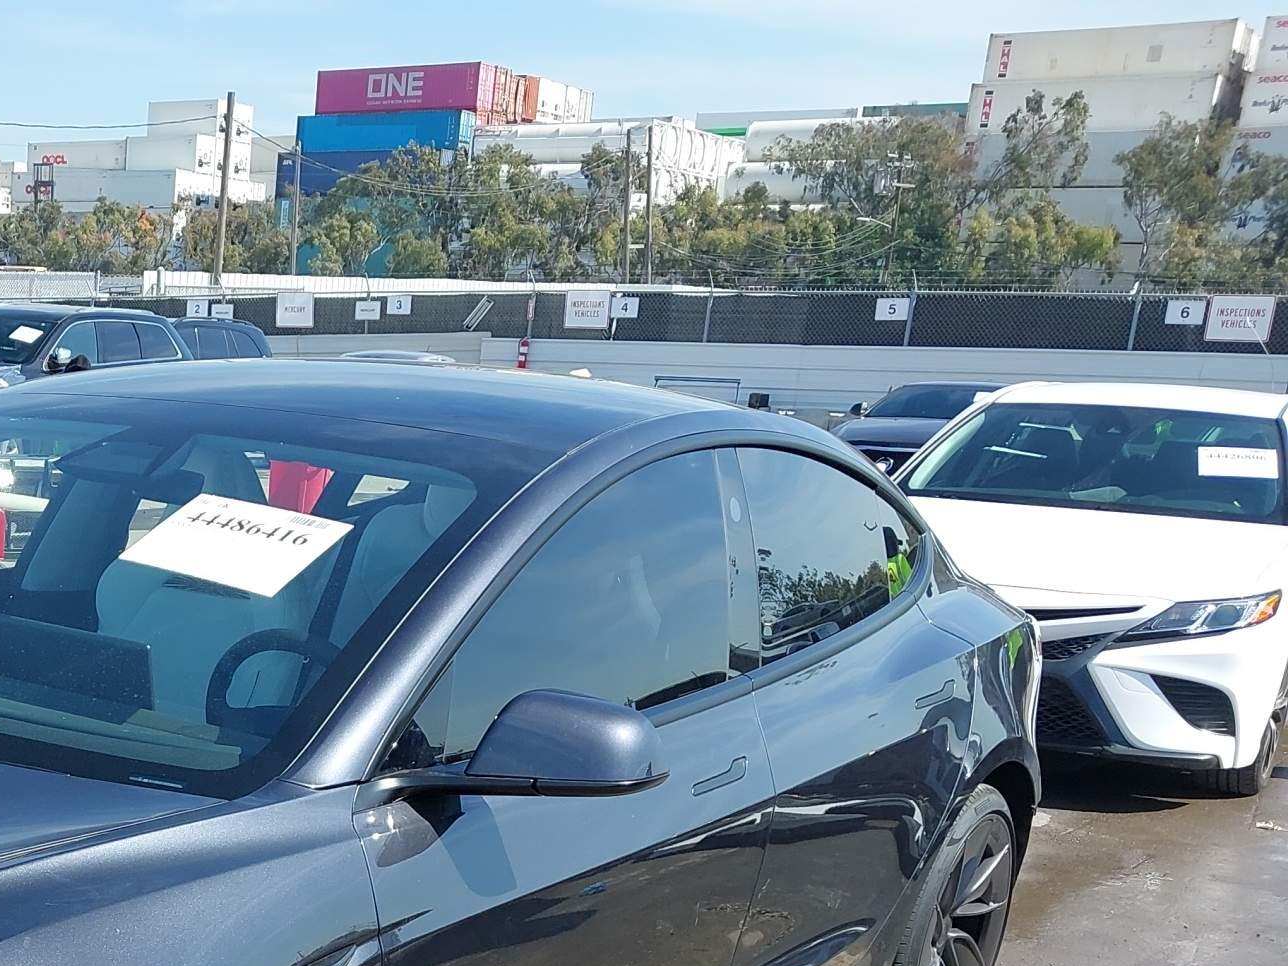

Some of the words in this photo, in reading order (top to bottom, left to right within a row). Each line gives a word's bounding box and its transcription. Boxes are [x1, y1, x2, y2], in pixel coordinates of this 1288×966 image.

[367, 72, 424, 97] ONE
[42, 155, 67, 165] OOCL
[194, 304, 200, 314] 2
[396, 300, 402, 310] 3
[621, 302, 628, 312] 4
[888, 304, 896, 315] 5
[1180, 306, 1190, 319] 6
[1216, 307, 1267, 317] INSPECTIONS
[187, 511, 312, 546] 44486416
